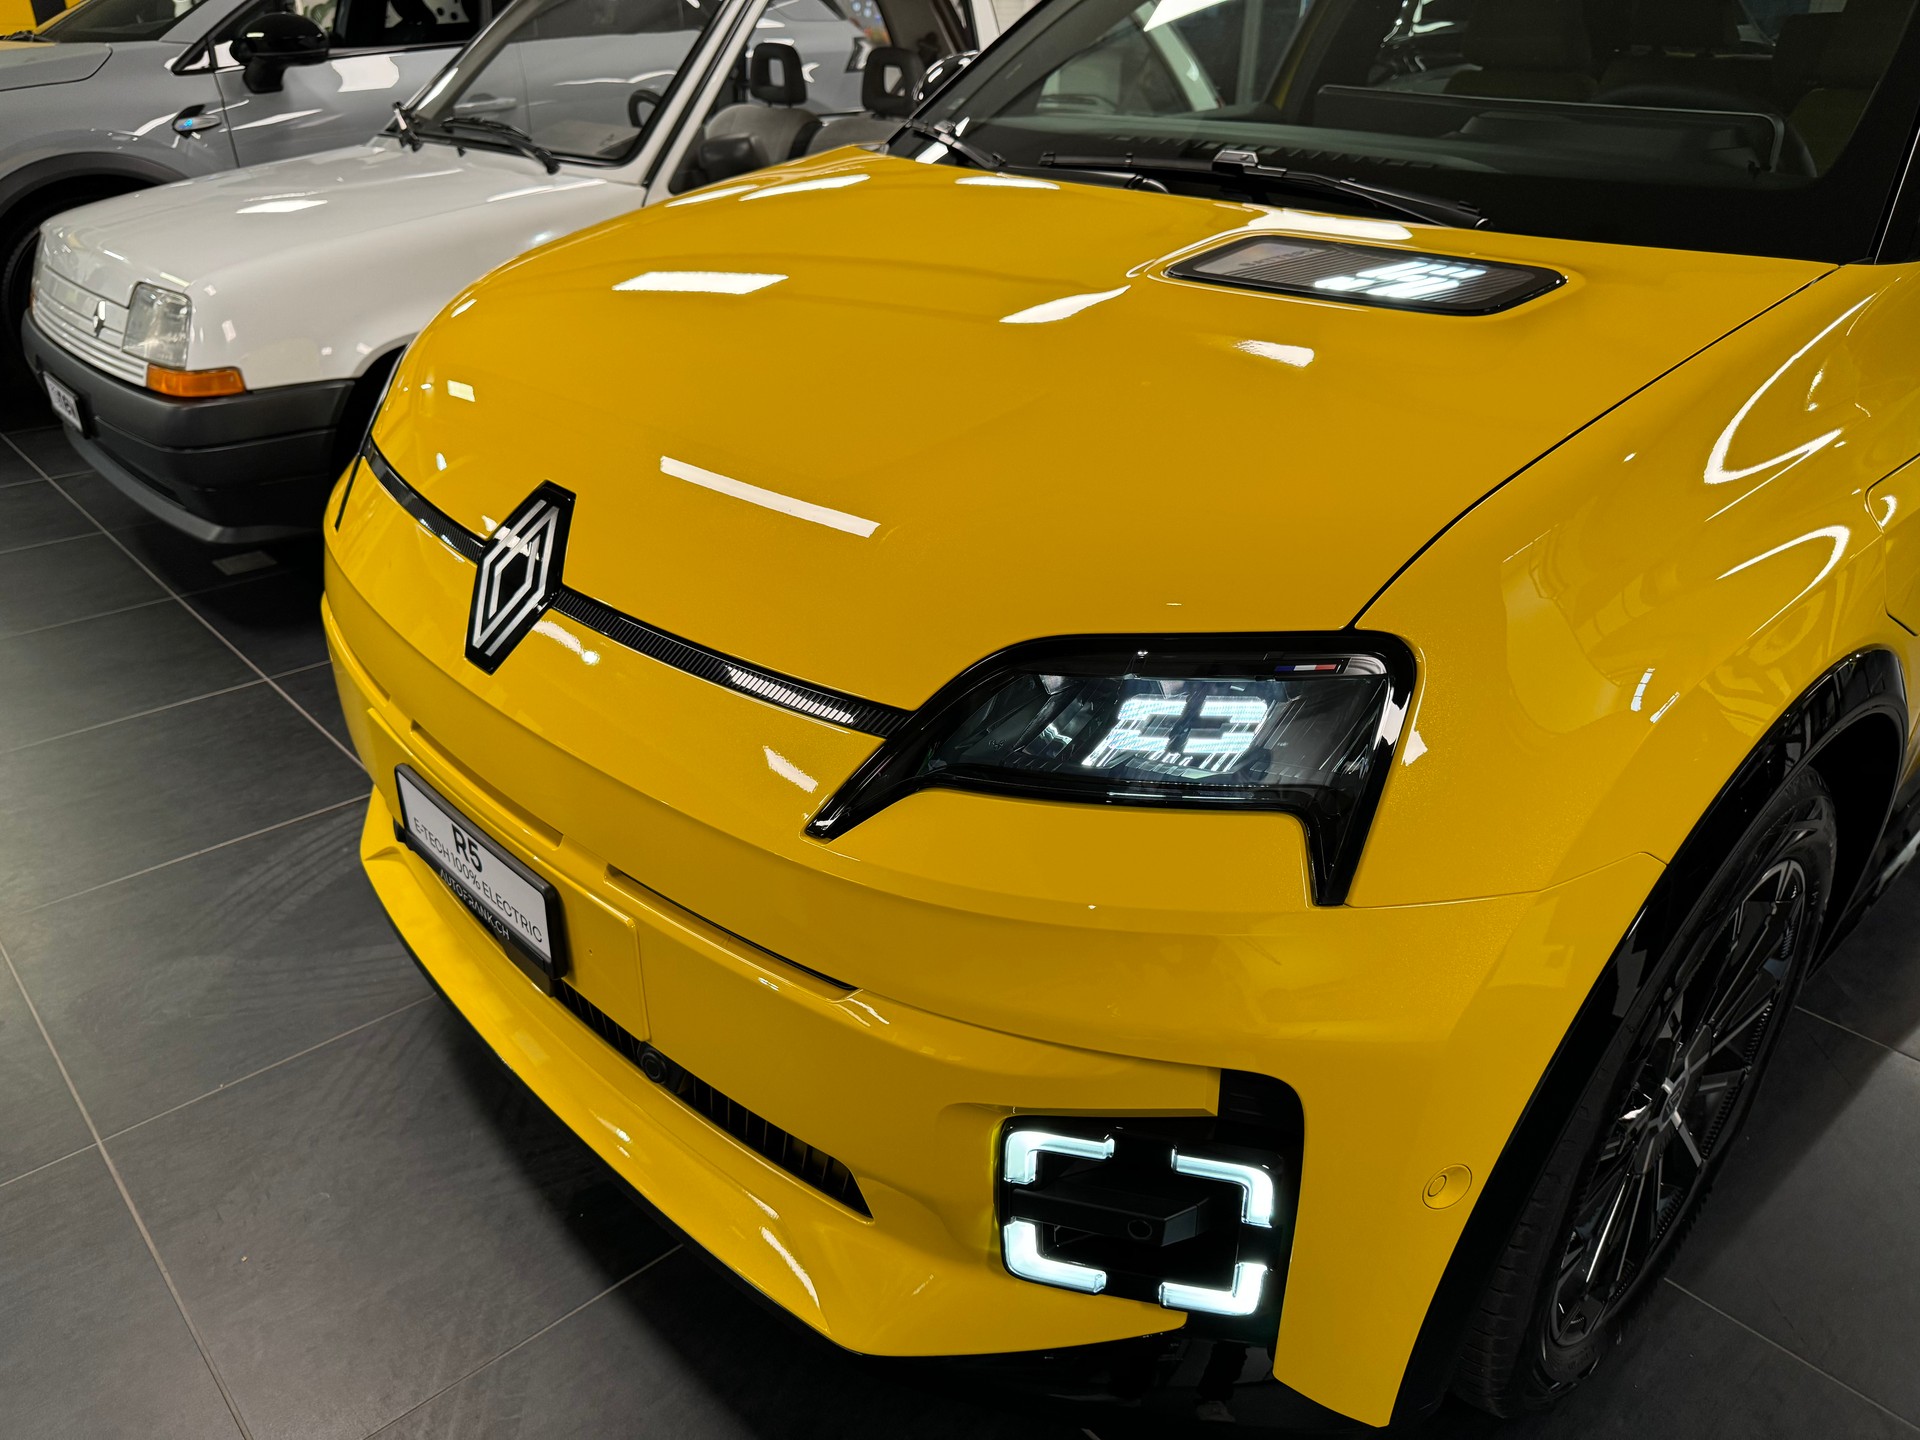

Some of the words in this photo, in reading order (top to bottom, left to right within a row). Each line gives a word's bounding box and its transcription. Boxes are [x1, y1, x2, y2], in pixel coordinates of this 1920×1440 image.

[413, 817, 451, 862] E-TECH
[451, 852, 481, 890] 100%
[482, 880, 543, 943] ELECTRIC
[451, 823, 483, 873] R5
